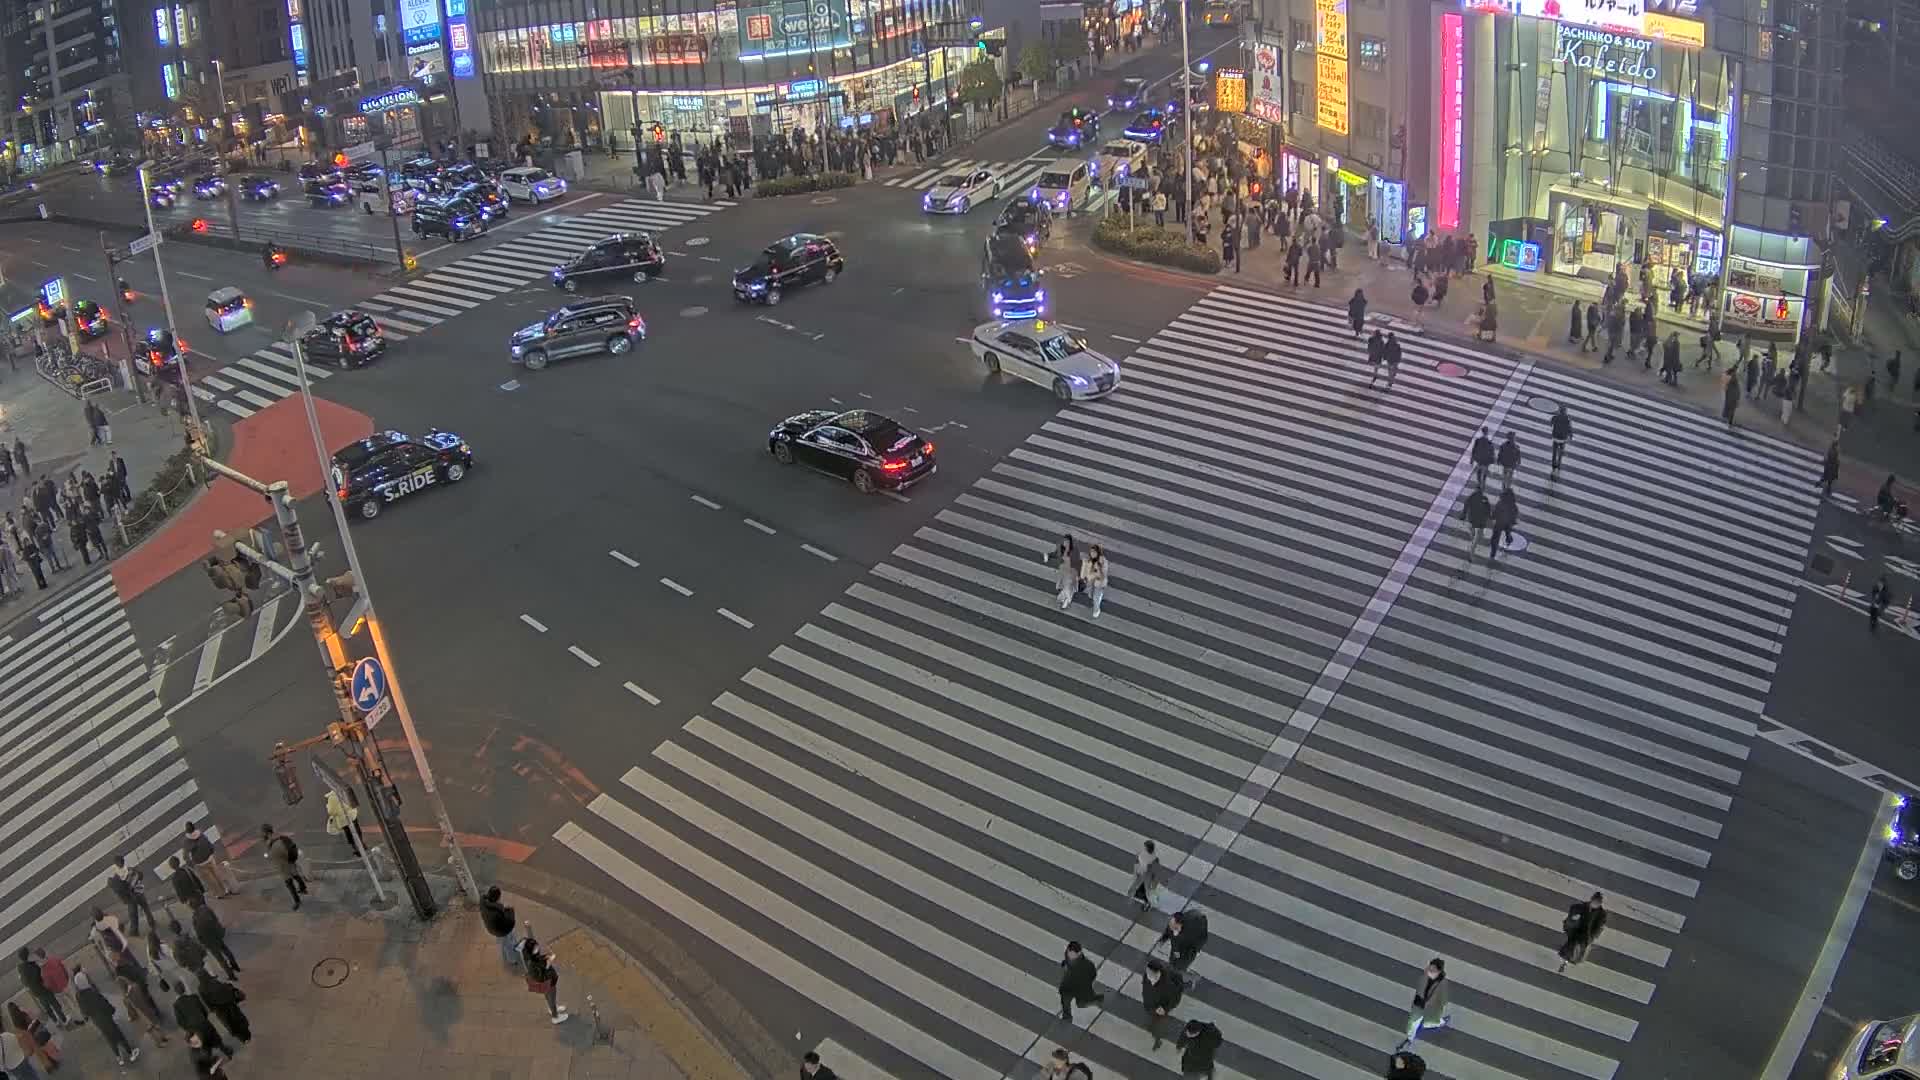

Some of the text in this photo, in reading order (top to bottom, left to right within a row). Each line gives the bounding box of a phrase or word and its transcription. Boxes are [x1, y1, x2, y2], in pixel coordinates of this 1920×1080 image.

[1558, 25, 1612, 43] PACHINKO
[1614, 35, 1623, 46] &
[1625, 37, 1652, 51] SLOT
[1552, 40, 1657, 79] Kaleido
[383, 469, 437, 502] S.RIDE
